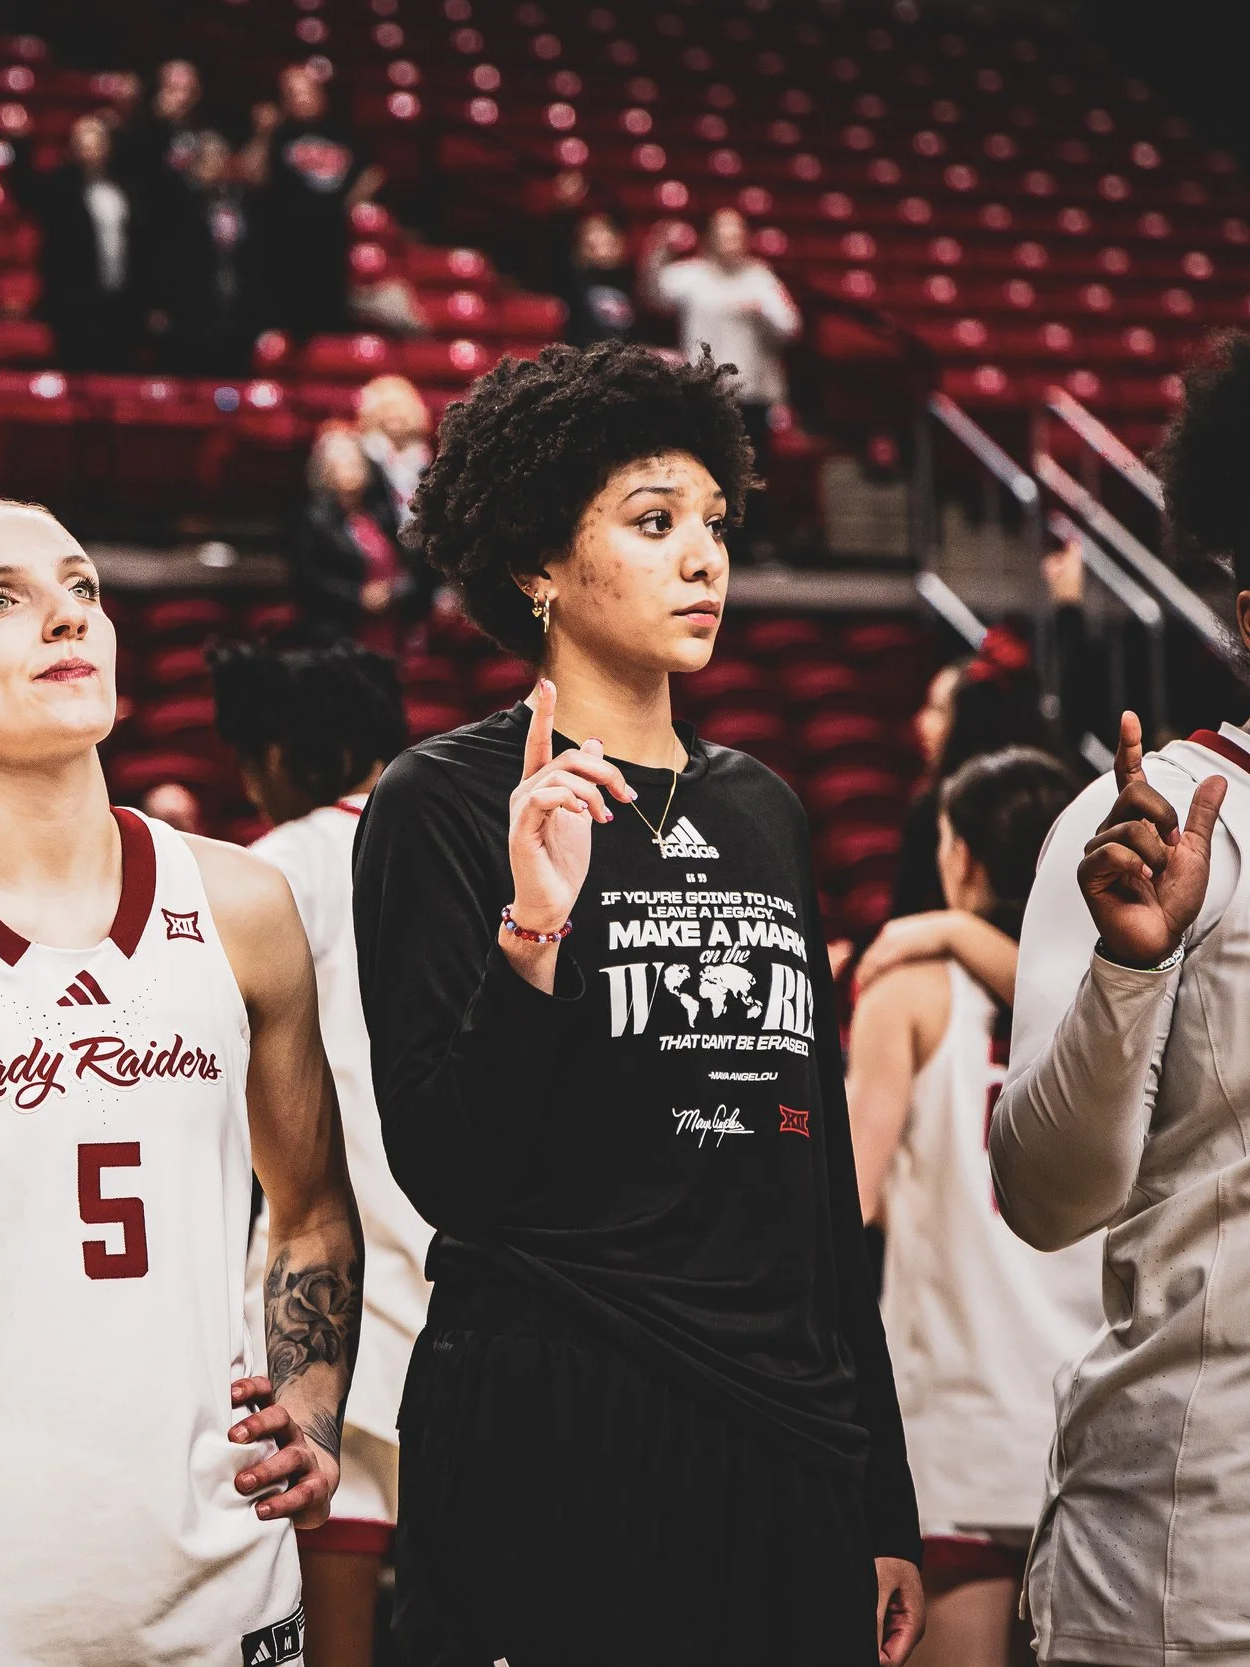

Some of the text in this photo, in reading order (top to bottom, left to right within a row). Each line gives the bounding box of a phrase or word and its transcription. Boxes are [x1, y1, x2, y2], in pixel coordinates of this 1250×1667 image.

[665, 844, 720, 859] adidas
[601, 891, 797, 919] IF YOU'RE GOING TO LIVE,
[648, 906, 776, 920] LEAVE A LEGACY.
[608, 920, 808, 963] MAKE A MARK
[699, 941, 751, 963] on the
[659, 1035, 700, 1051] THAT
[735, 1036, 756, 1050] BE
[69, 1033, 223, 1087] Raiders
[729, 1072, 778, 1081] ANGELOU
[78, 1141, 149, 1280] 5
[284, 1635, 292, 1651] M
